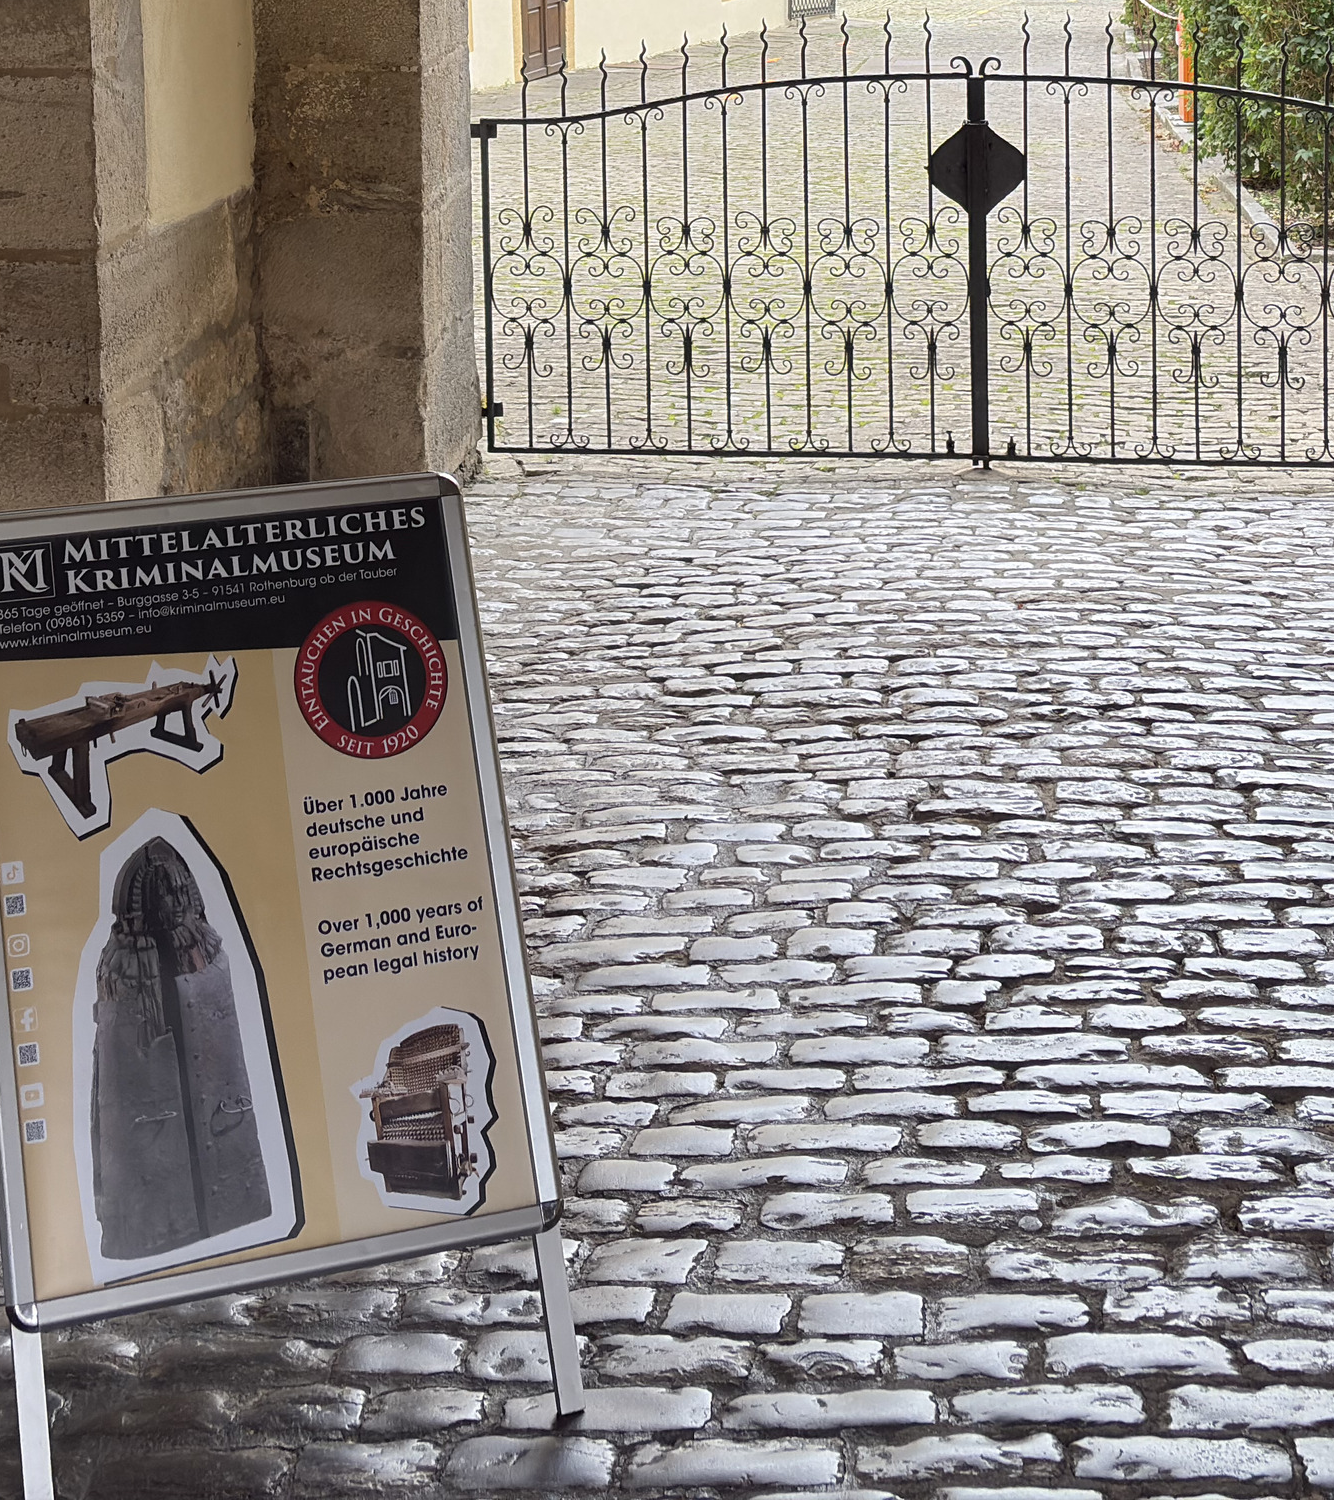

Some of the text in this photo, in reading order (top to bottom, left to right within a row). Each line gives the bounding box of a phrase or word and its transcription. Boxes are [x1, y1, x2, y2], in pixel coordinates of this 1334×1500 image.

[62, 506, 426, 565] MITTELALTERLICHES
[64, 540, 398, 595] KRIMINALMUSEUM
[20, 605, 51, 619] Tage
[54, 598, 105, 617] geöffnet
[117, 591, 179, 608] Burggasse
[182, 588, 200, 600] 3-5
[211, 583, 245, 597] 91541
[249, 576, 317, 593] Rothenburg
[319, 573, 336, 585] ob
[338, 571, 357, 583] der
[359, 567, 398, 581] Tauber
[45, 614, 93, 632] (09861)
[96, 610, 125, 624] 5359
[138, 594, 286, 620] info@kriminalmuseum.eu
[301, 607, 443, 732] EINTAUCHEN IN GESCHICHTE
[336, 724, 419, 756] SEIT 1920
[303, 783, 448, 816] Über 1.000 Jahre
[305, 806, 425, 838] deutsche und
[308, 831, 420, 860] europäische
[311, 846, 469, 883] Rechtsgeschichte
[317, 895, 484, 936] Over 1,000 years of
[320, 922, 478, 958] German and Euro-
[323, 944, 480, 985] pean legal history
